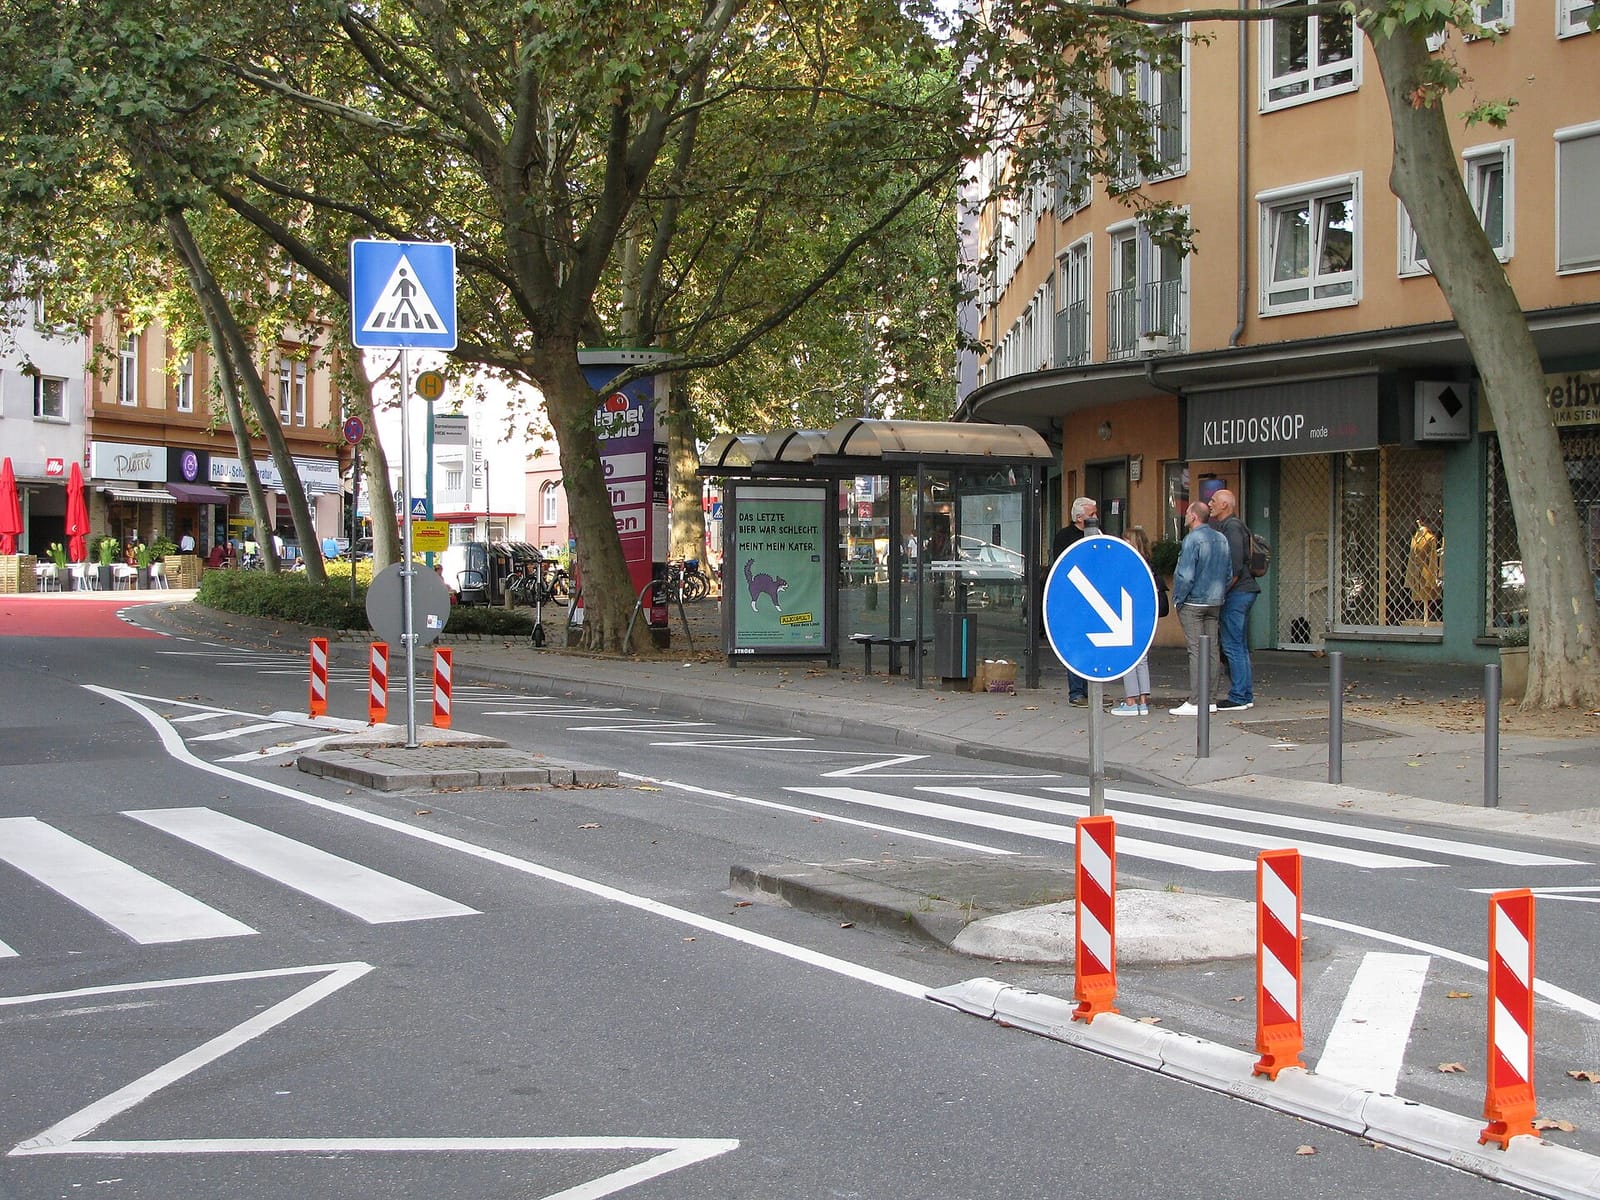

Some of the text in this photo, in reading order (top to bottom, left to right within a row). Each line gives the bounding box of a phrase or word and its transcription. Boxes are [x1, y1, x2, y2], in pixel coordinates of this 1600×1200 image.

[425, 377, 437, 395] H
[1556, 408, 1600, 422] IKA STEN
[1203, 414, 1304, 446] KLEIDOSKOP
[1309, 426, 1328, 439] mode
[48, 461, 63, 474] illy
[602, 459, 615, 477] b
[608, 487, 626, 504] in
[616, 516, 638, 531] en
[739, 513, 785, 521] DAS LETZTE
[739, 526, 819, 535] BIER WAR SCHLECHT.
[739, 542, 816, 551] MEINT MEIN KATER.
